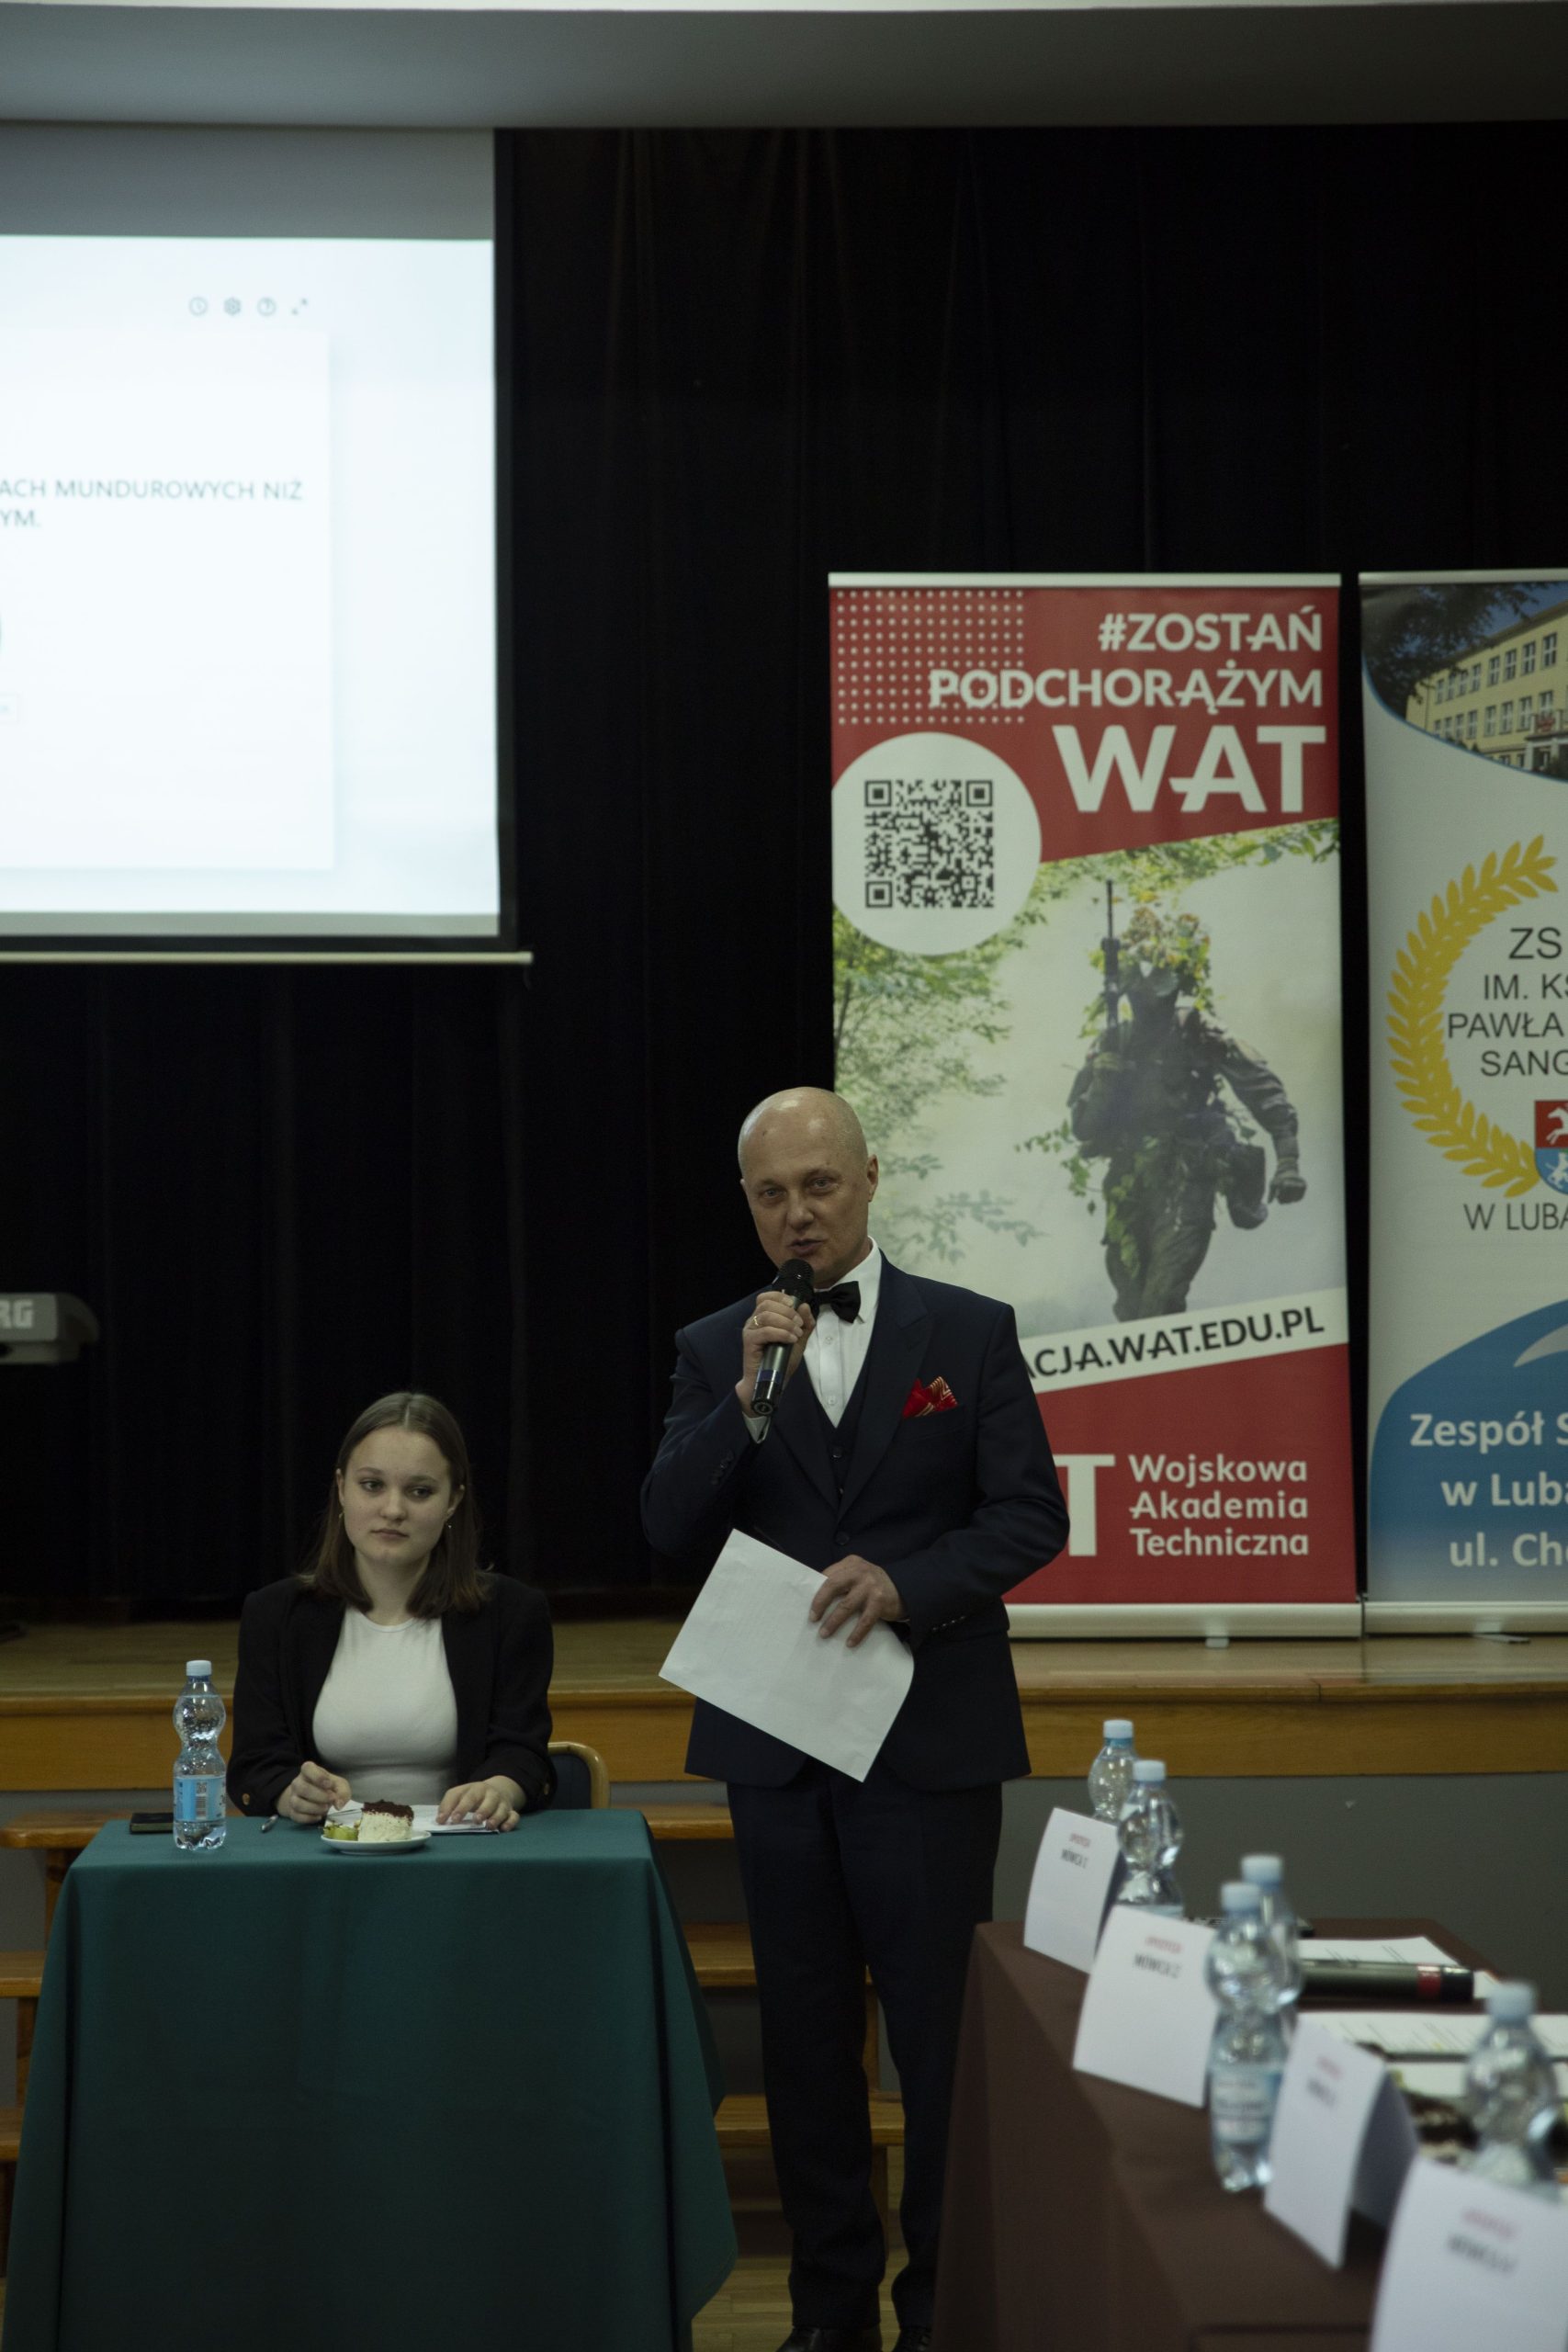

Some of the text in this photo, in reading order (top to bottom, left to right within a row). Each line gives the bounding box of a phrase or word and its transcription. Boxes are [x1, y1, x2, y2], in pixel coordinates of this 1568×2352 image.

[55, 479, 254, 500] MUNDUROWYCH
[264, 477, 304, 500] NIŻ
[1098, 605, 1323, 653] #ZOSTAŃ
[928, 660, 1323, 715] PODCHORĄŻYM
[1052, 724, 1326, 813] WAT
[1508, 926, 1563, 960] ZS
[1483, 973, 1529, 1001] IM.
[1448, 1012, 1565, 1039] PAWŁA
[1463, 1203, 1496, 1231] W
[1410, 1410, 1545, 1454] Zespół
[1128, 1453, 1308, 1488] Wojskowa
[1128, 1490, 1309, 1519] Akademia
[1440, 1471, 1568, 1507] w Lub
[1129, 1527, 1309, 1555] Techniczna
[1450, 1532, 1568, 1567] ul. Ch
